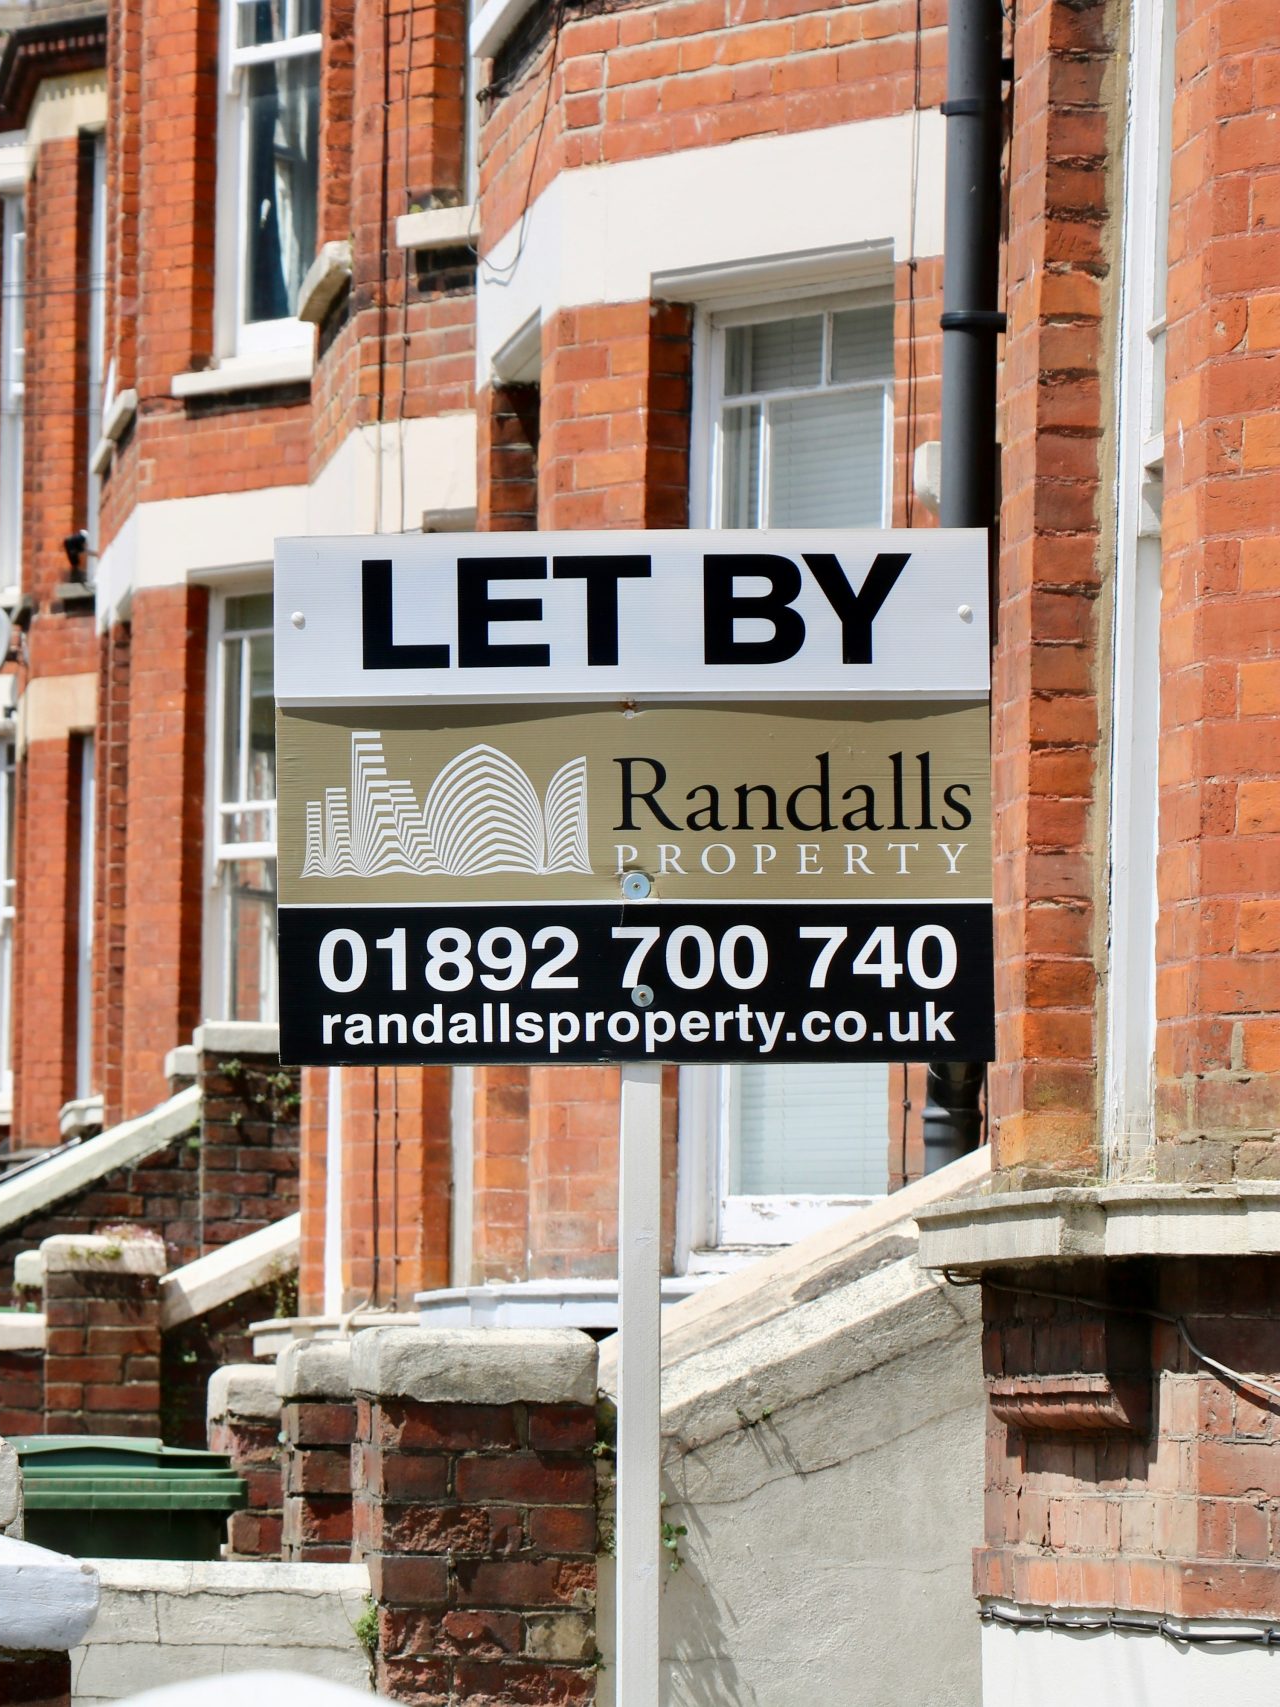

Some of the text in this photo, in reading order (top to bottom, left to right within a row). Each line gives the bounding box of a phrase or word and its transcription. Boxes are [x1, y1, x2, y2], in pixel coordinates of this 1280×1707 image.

[362, 552, 912, 669] LET BY
[612, 751, 972, 833] Randalls
[614, 842, 969, 875] PROPERTY
[318, 924, 958, 992] 01892 700 740
[322, 1001, 956, 1053] randallsproperty.co.uk
